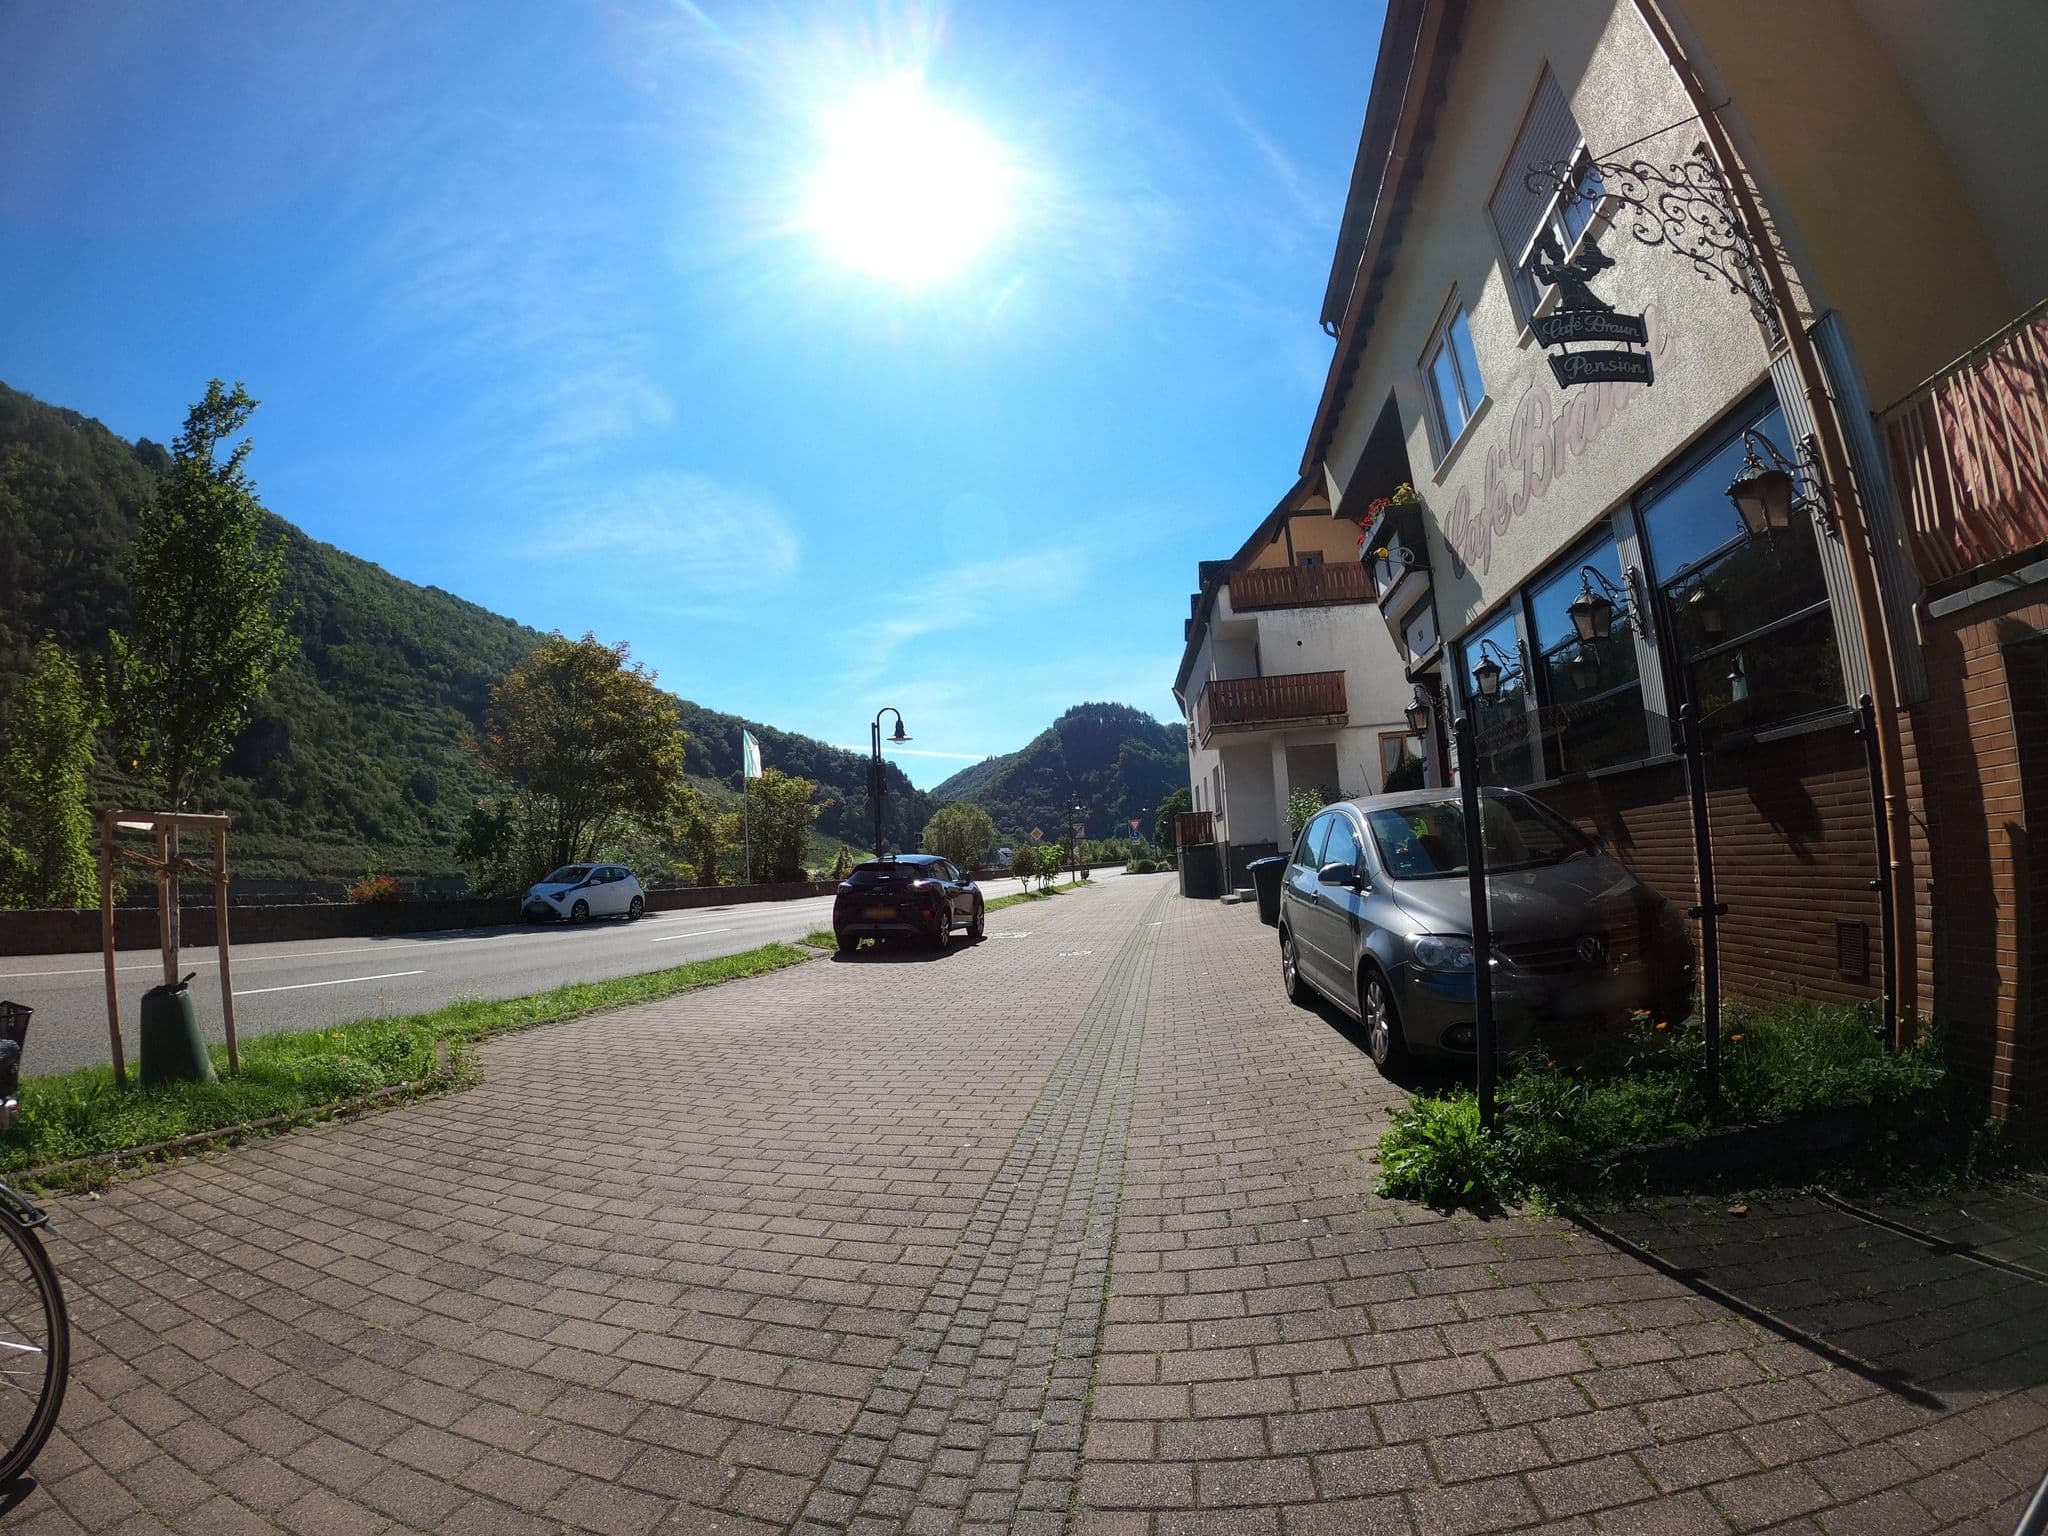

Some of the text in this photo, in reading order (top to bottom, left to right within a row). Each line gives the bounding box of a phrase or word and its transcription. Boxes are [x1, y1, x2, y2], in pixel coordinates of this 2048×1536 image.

[1542, 315, 1640, 338] Café Braun
[1565, 355, 1645, 378] Pension
[1444, 445, 1511, 579] Café
